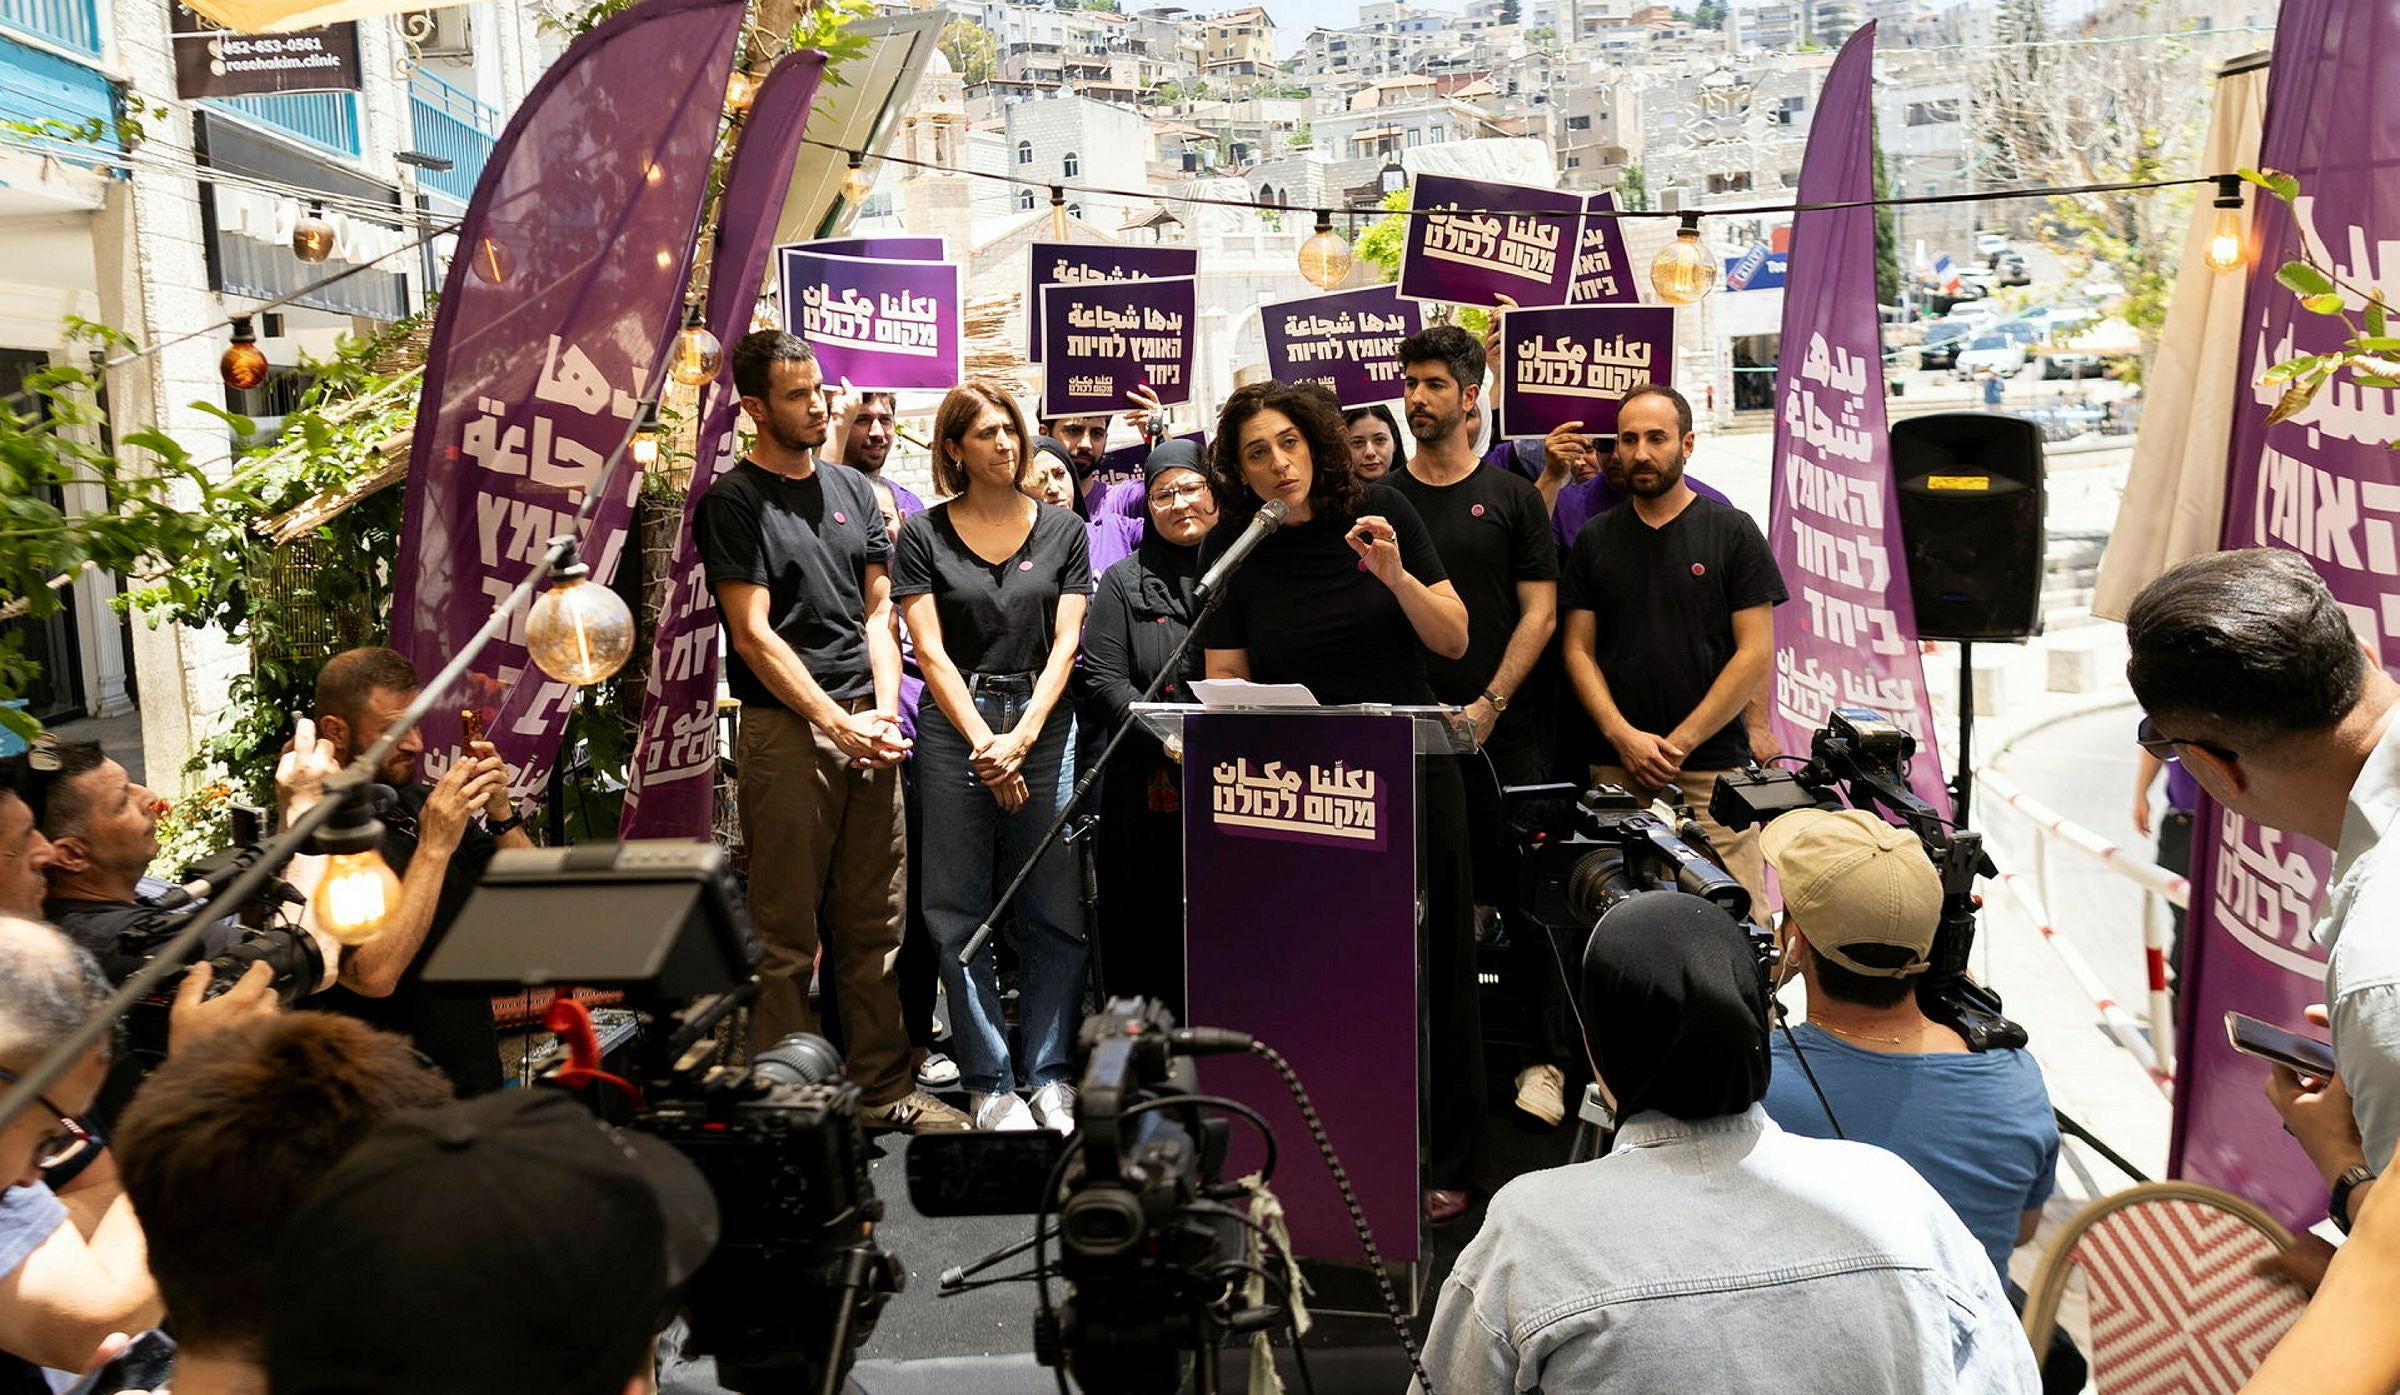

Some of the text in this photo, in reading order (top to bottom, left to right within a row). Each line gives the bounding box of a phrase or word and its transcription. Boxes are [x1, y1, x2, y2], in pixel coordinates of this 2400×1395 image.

[226, 53, 340, 72] rosehakim.clinic
[1428, 202, 1503, 238] مكان
[1424, 222, 1557, 275] מקום לכולנו
[803, 283, 875, 318] مكان
[803, 306, 938, 347] מקום לכולנו
[1068, 302, 1182, 336] بدها شجاعة
[1284, 311, 1406, 338] بدها شجاعة
[1067, 333, 1182, 362] האומץ לחיות
[1286, 338, 1344, 362] לחיות
[1517, 335, 1588, 363] مكان
[1144, 364, 1180, 385] ביחד
[1517, 357, 1651, 394] מקום לכולנו
[1785, 376, 1873, 463] شجاعة
[462, 395, 604, 505] جاعة
[1786, 452, 1885, 530] האומץ
[1791, 516, 1891, 593] לבחור
[1803, 586, 1906, 656] ביחד
[1213, 757, 1303, 793] مكان
[1213, 782, 1376, 830] מקום לכולנו
